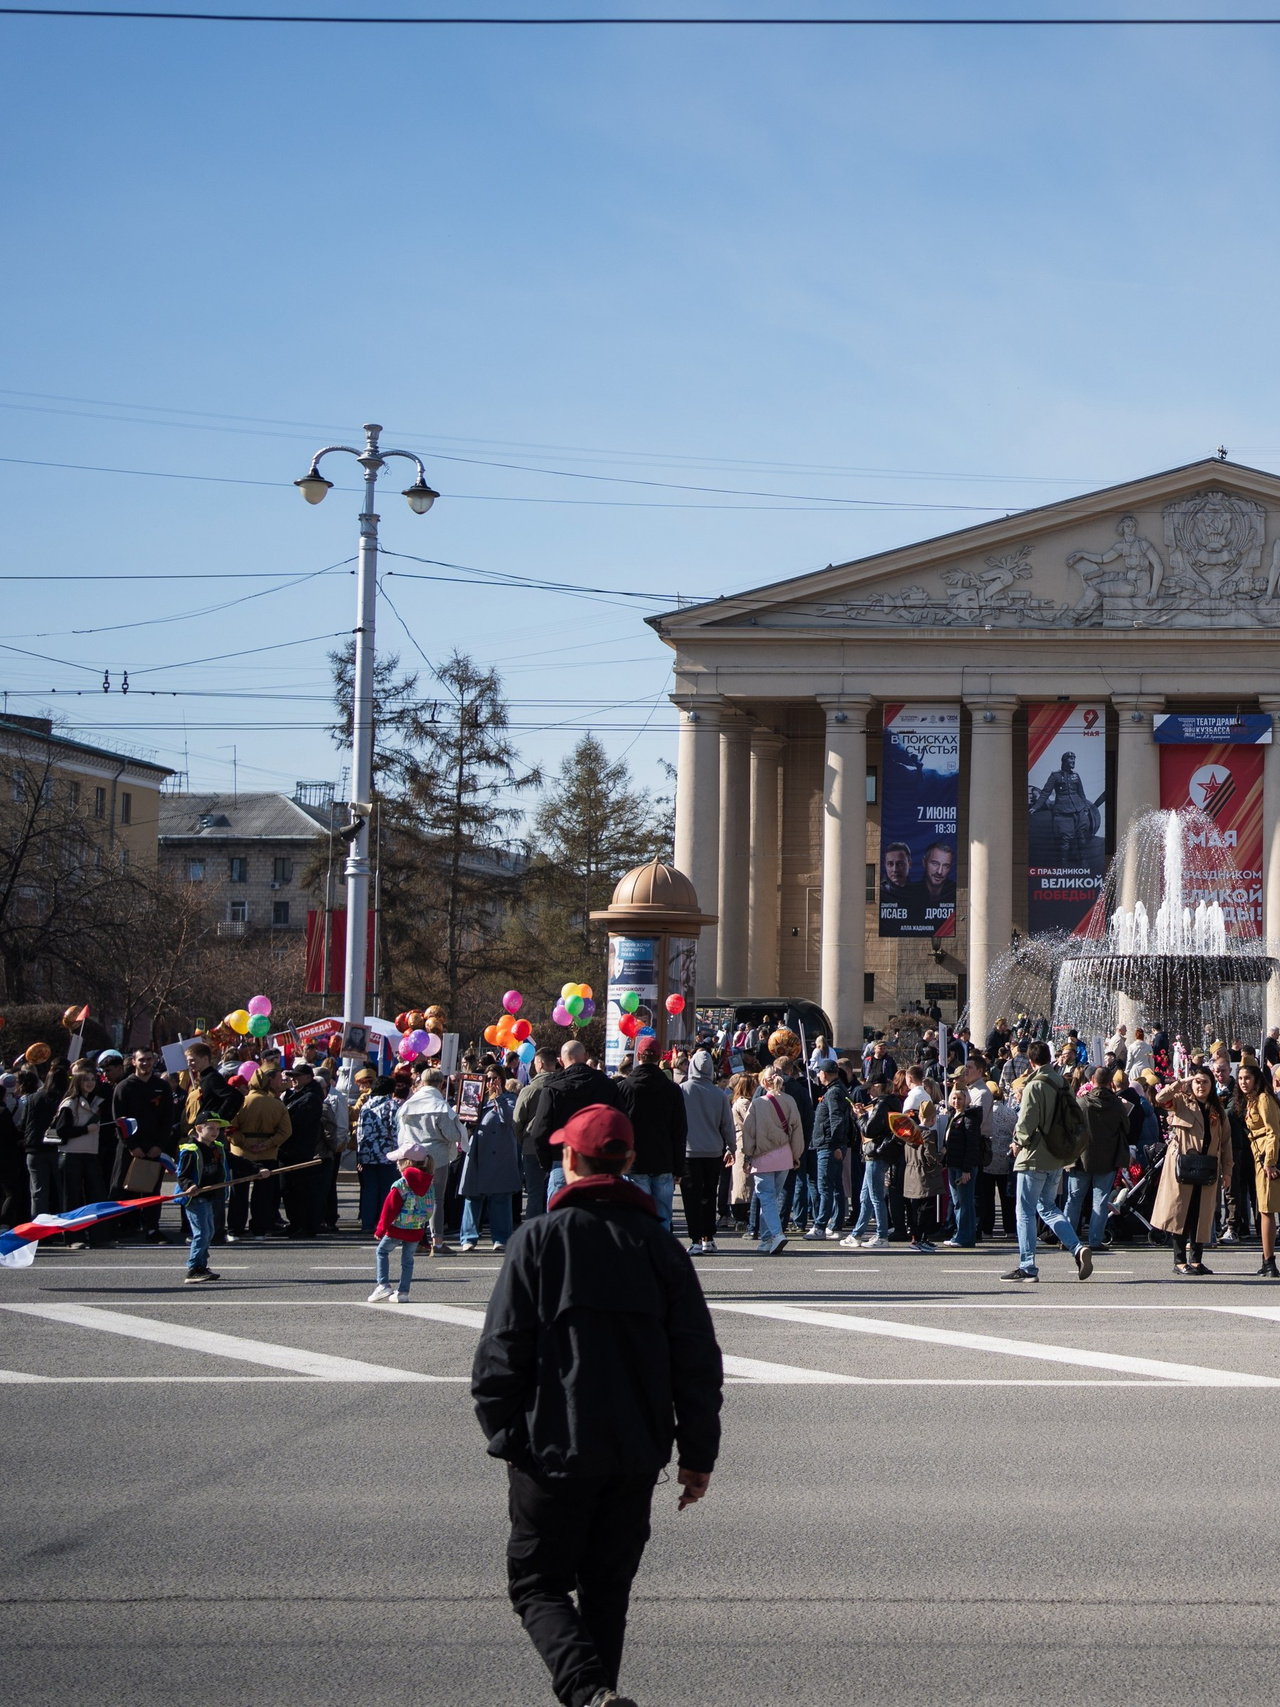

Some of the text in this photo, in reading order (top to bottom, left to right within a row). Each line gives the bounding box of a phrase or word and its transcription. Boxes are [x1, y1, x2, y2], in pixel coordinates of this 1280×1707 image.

[1196, 717, 1215, 726] ТЕАТР
[1196, 726, 1230, 735] КУЗБАССА
[891, 735, 958, 744] В ПОИСКАХ
[905, 745, 958, 755] СЧАСТЬЯ
[917, 806, 957, 820] 7 ИЮНЯ
[935, 823, 957, 834] 18:30
[1187, 830, 1237, 847] МАЯ
[1037, 868, 1091, 876] ПРАЗДНИКОМ
[1041, 874, 1103, 889] ВЕЛИКОЙ
[1033, 889, 1096, 902] ПОБЕДЫ!
[1181, 884, 1263, 903] ЕЛИКОЙ
[881, 908, 908, 919] ИСАЕВ
[299, 1021, 332, 1039] ПОБЕДА!
